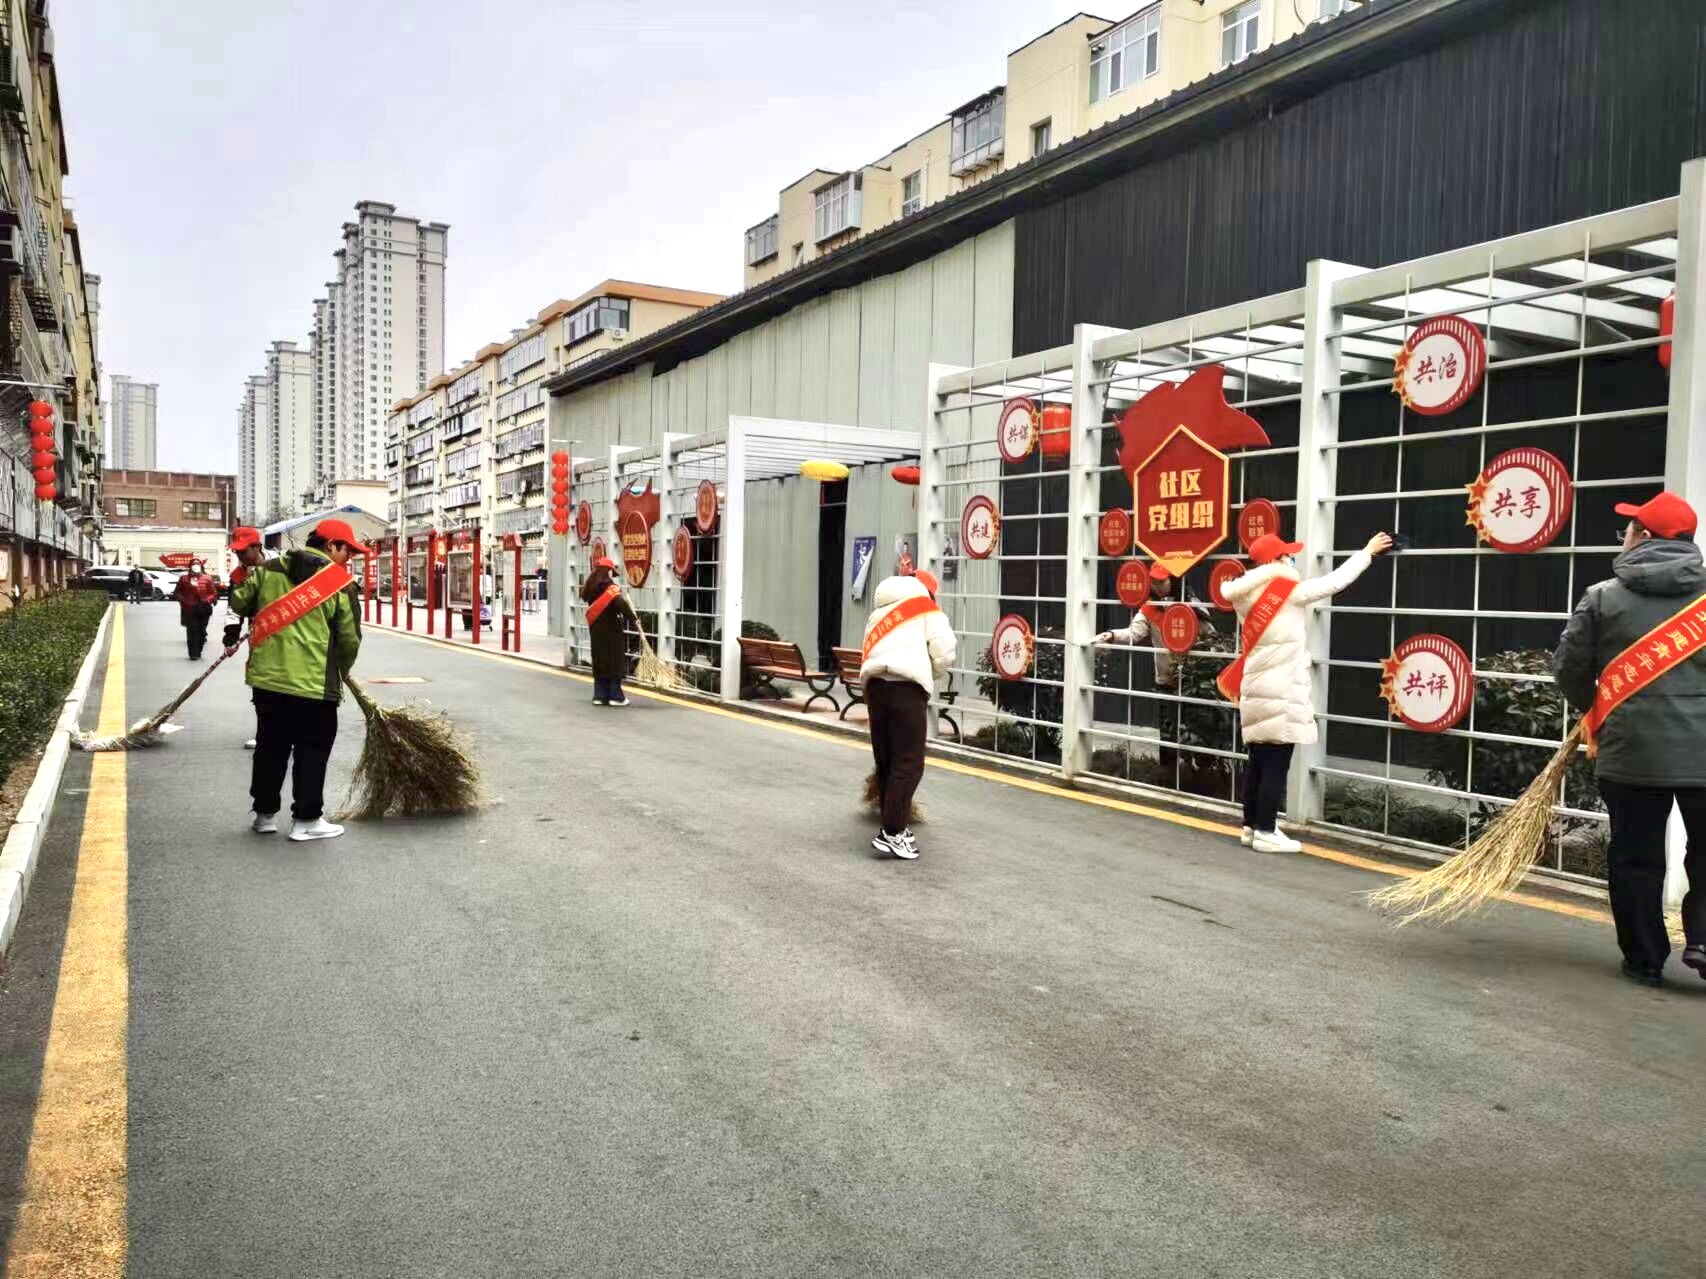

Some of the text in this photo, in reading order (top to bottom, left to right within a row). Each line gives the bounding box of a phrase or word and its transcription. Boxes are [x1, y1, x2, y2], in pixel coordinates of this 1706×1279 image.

[1412, 353, 1458, 384] 共治
[1159, 469, 1202, 499] 社区
[1148, 500, 1214, 532] 党组织
[1490, 486, 1542, 519] 共享
[1402, 671, 1449, 700] 共评
